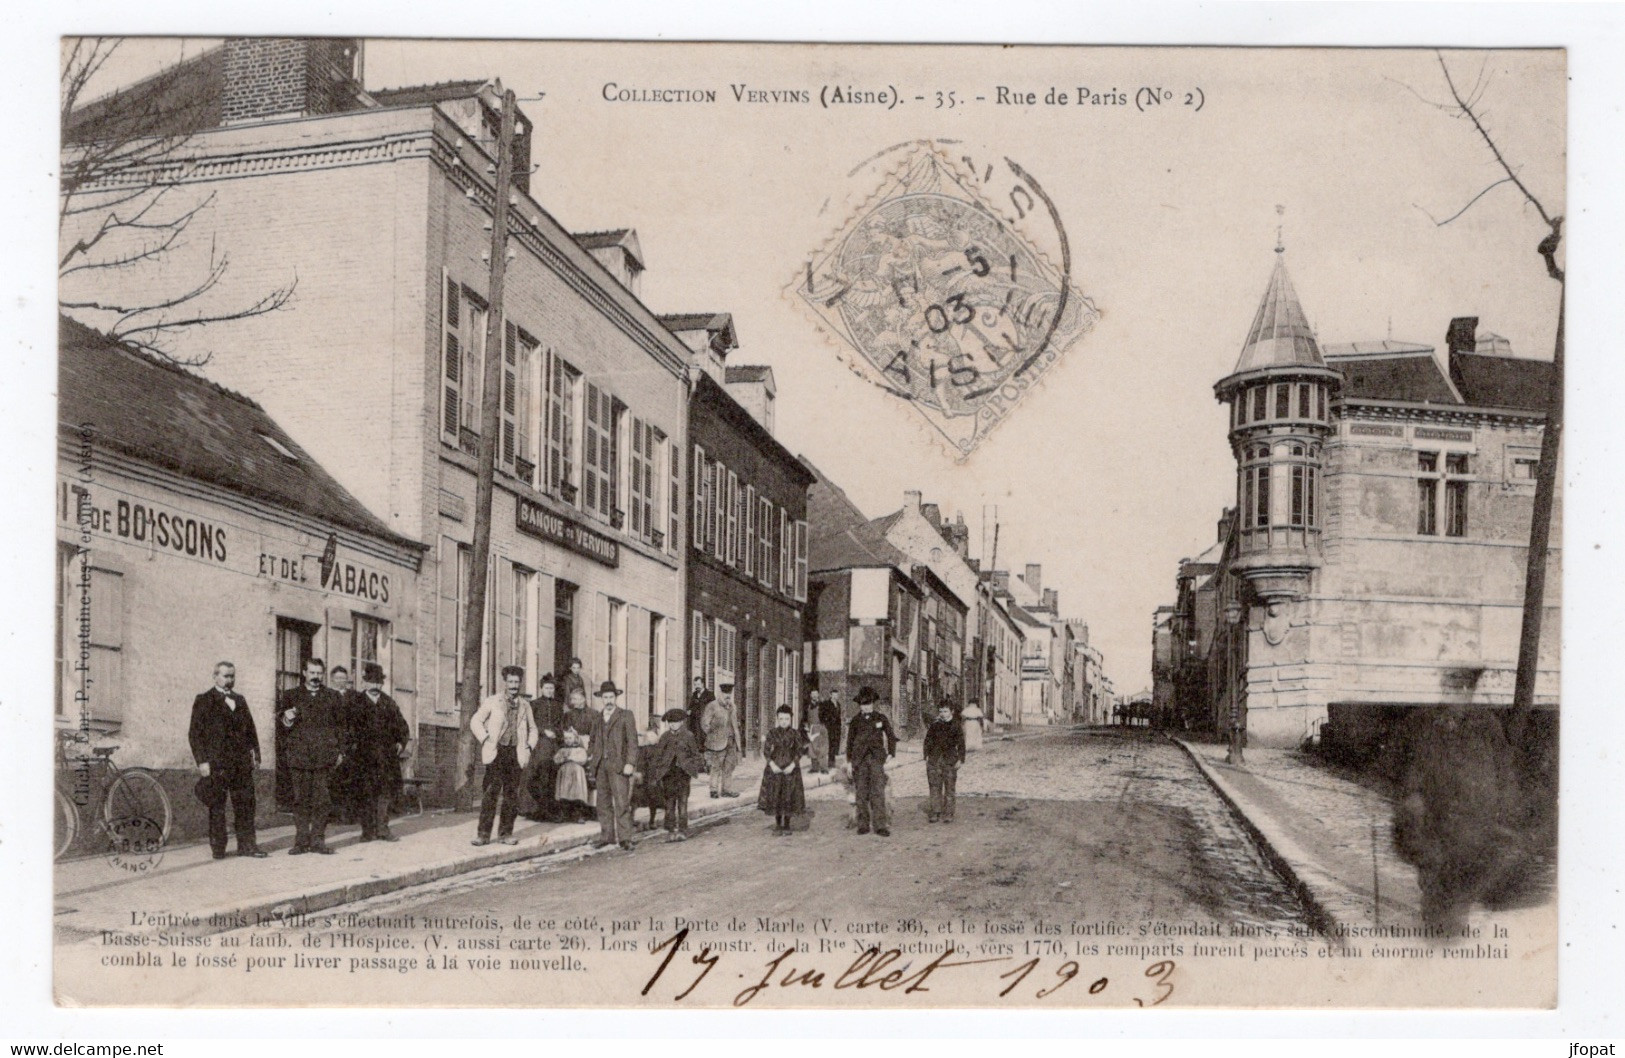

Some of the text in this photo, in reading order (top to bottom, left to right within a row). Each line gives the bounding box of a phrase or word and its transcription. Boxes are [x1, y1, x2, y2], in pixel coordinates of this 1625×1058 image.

[924, 292, 977, 333] 03
[987, 348, 1058, 415] POSTES
[91, 507, 113, 533] DE
[117, 500, 227, 562] BOISSONS
[259, 553, 277, 576] ET
[322, 557, 389, 603] ABACS
[520, 503, 565, 538] BANQUE
[575, 528, 616, 560] VERVINS
[113, 856, 154, 873] NANCY
[733, 946, 960, 1006] Juillet
[999, 957, 1176, 1007] 1903
